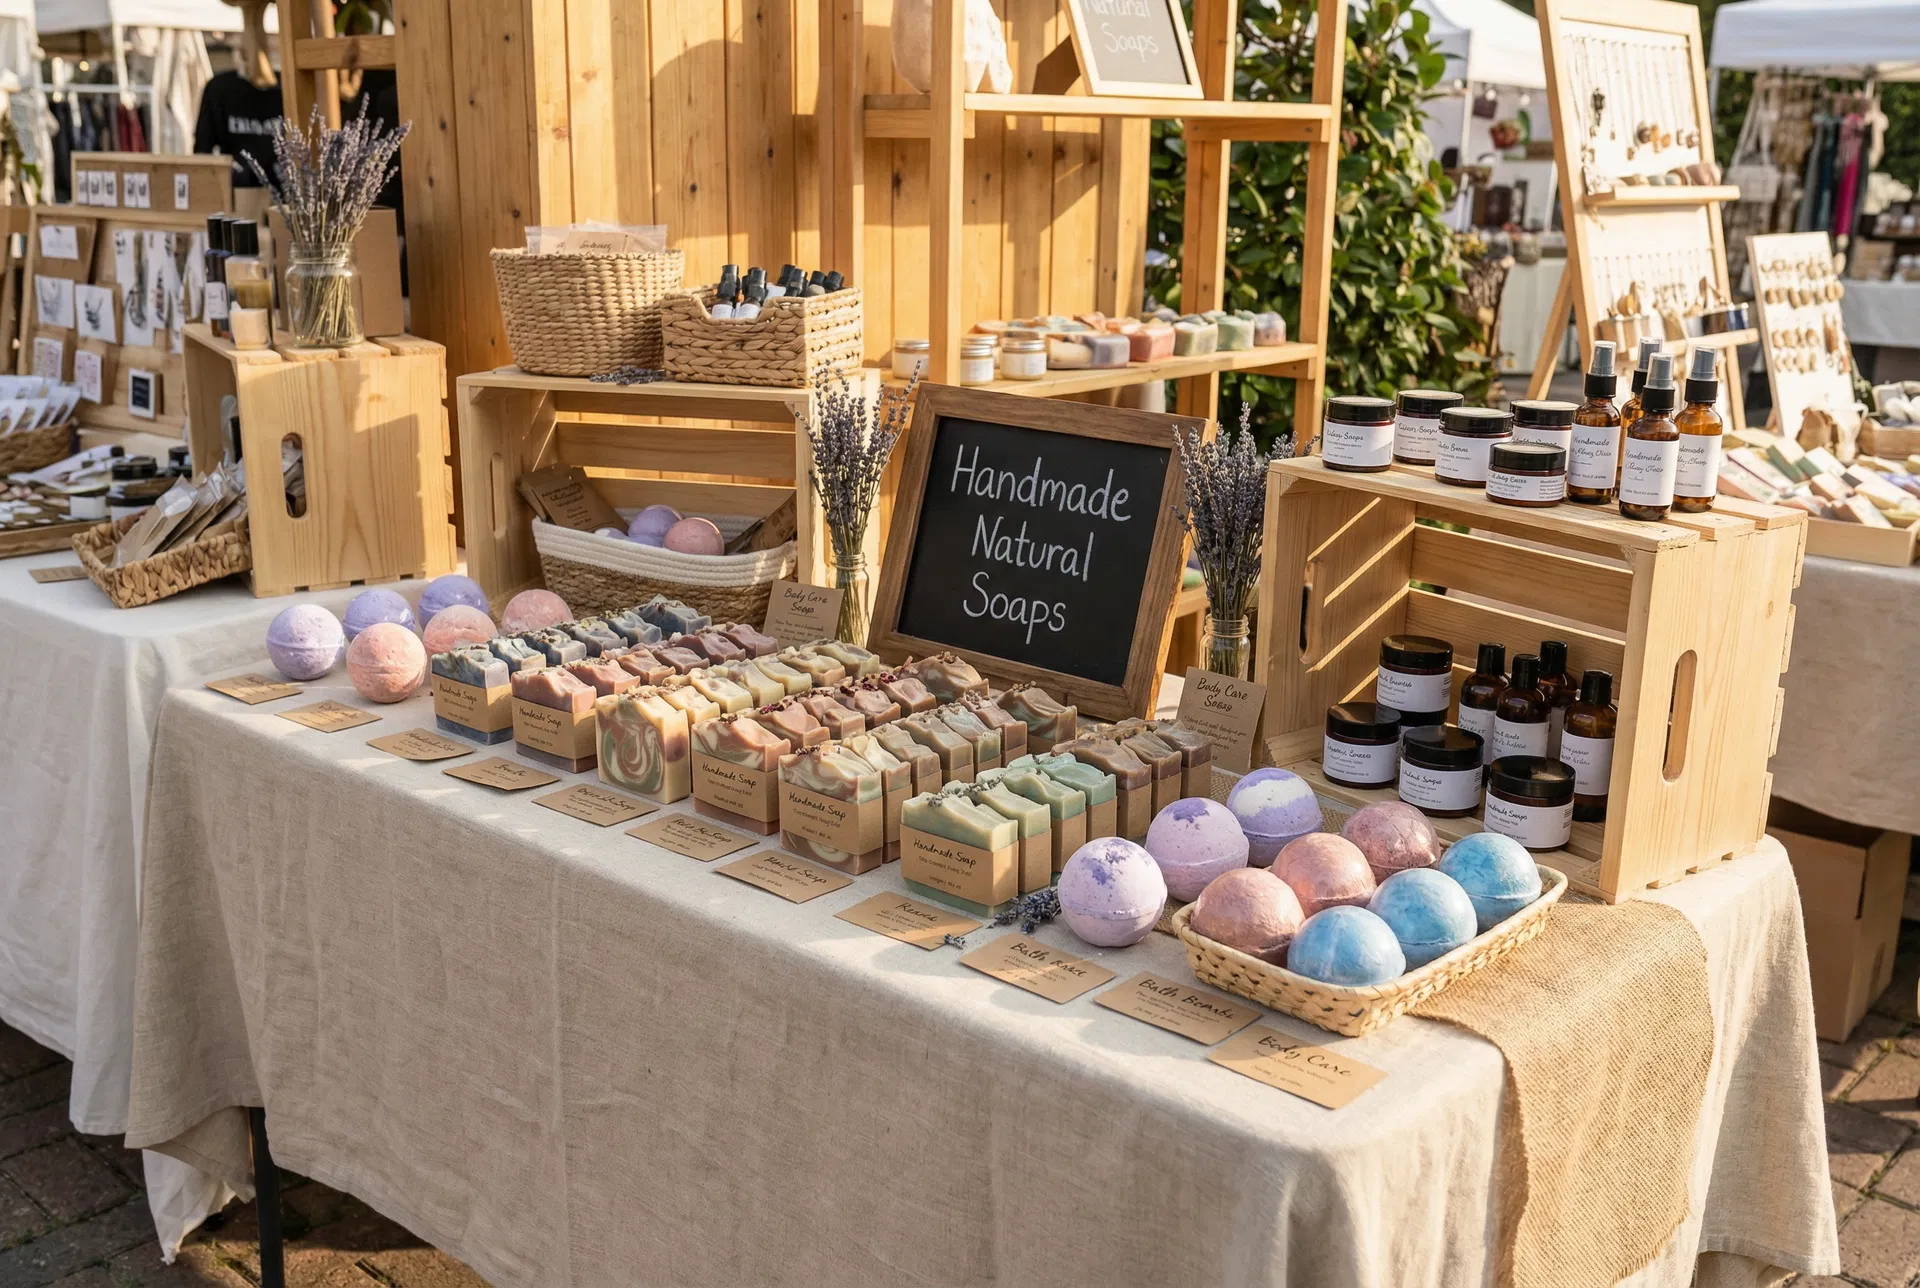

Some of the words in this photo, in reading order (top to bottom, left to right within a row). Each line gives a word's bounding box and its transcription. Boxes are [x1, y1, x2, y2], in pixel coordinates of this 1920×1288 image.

[1101, 22, 1159, 62] Soaps
[951, 444, 1131, 521] Handmade
[972, 514, 1095, 582] Natural
[963, 571, 1066, 645] Soaps
[1197, 677, 1221, 697] Body
[1225, 684, 1248, 700] Care
[913, 839, 953, 860] Handmade
[955, 852, 977, 868] Soap
[1010, 942, 1050, 961] Bath
[1138, 979, 1179, 998] Bath
[1307, 1055, 1352, 1077] Care
